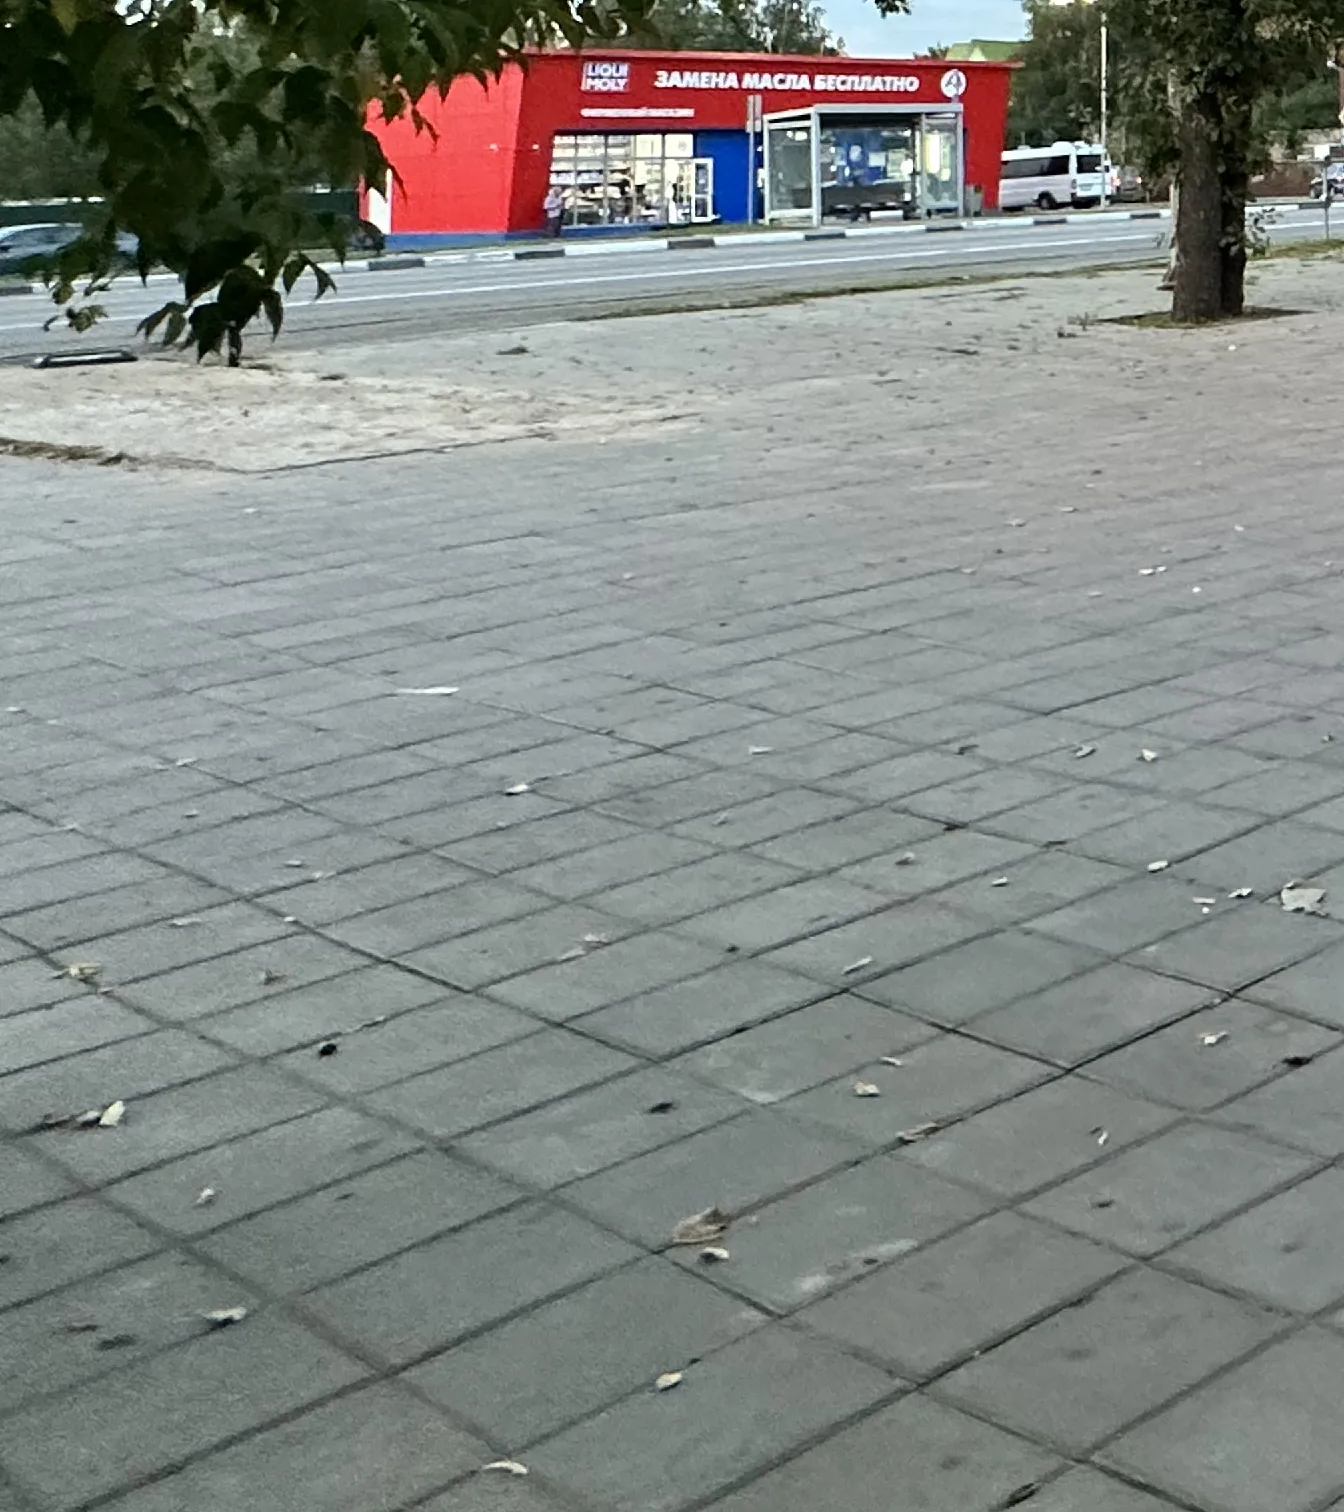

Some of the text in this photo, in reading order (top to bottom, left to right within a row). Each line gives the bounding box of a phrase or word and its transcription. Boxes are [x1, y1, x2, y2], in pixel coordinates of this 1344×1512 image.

[587, 78, 628, 91] MOLY
[654, 70, 920, 92] ЗАМЕНА МАСЛА БЕСПЛАТНО
